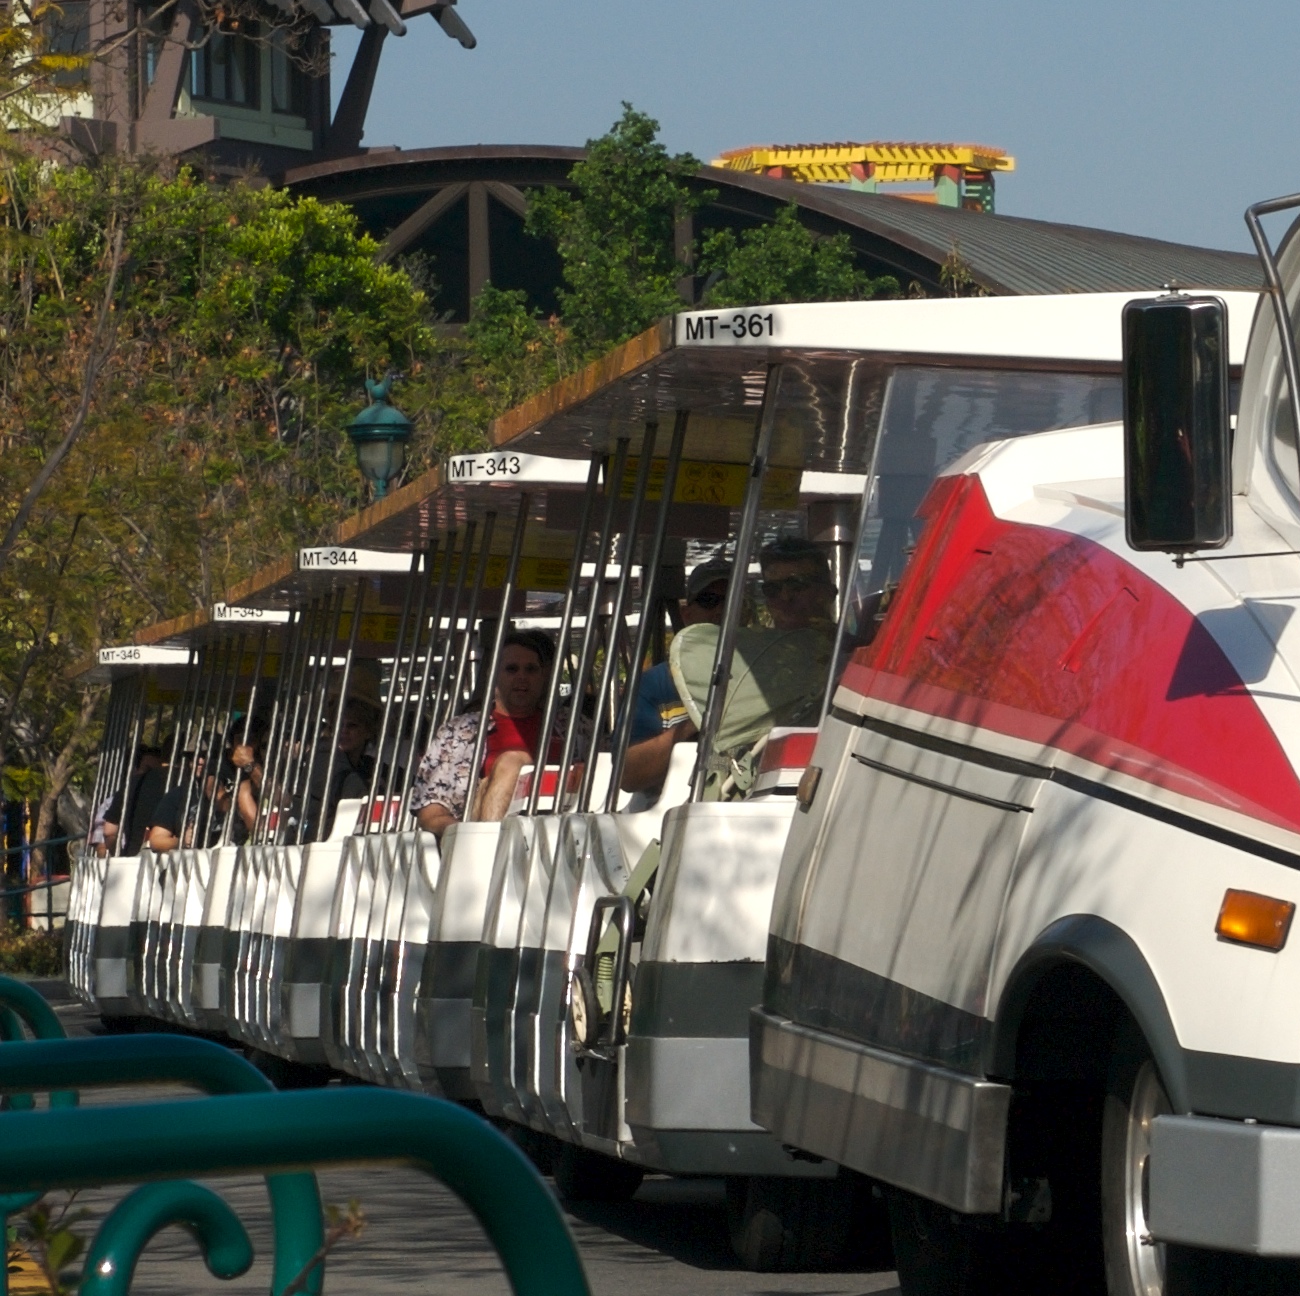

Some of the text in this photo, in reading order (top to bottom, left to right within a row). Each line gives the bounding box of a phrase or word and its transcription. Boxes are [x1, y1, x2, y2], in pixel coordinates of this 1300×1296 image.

[685, 313, 774, 341] MT-361
[451, 456, 521, 478] MT-343
[302, 551, 358, 567] MT-344
[101, 649, 141, 662] MT-346
